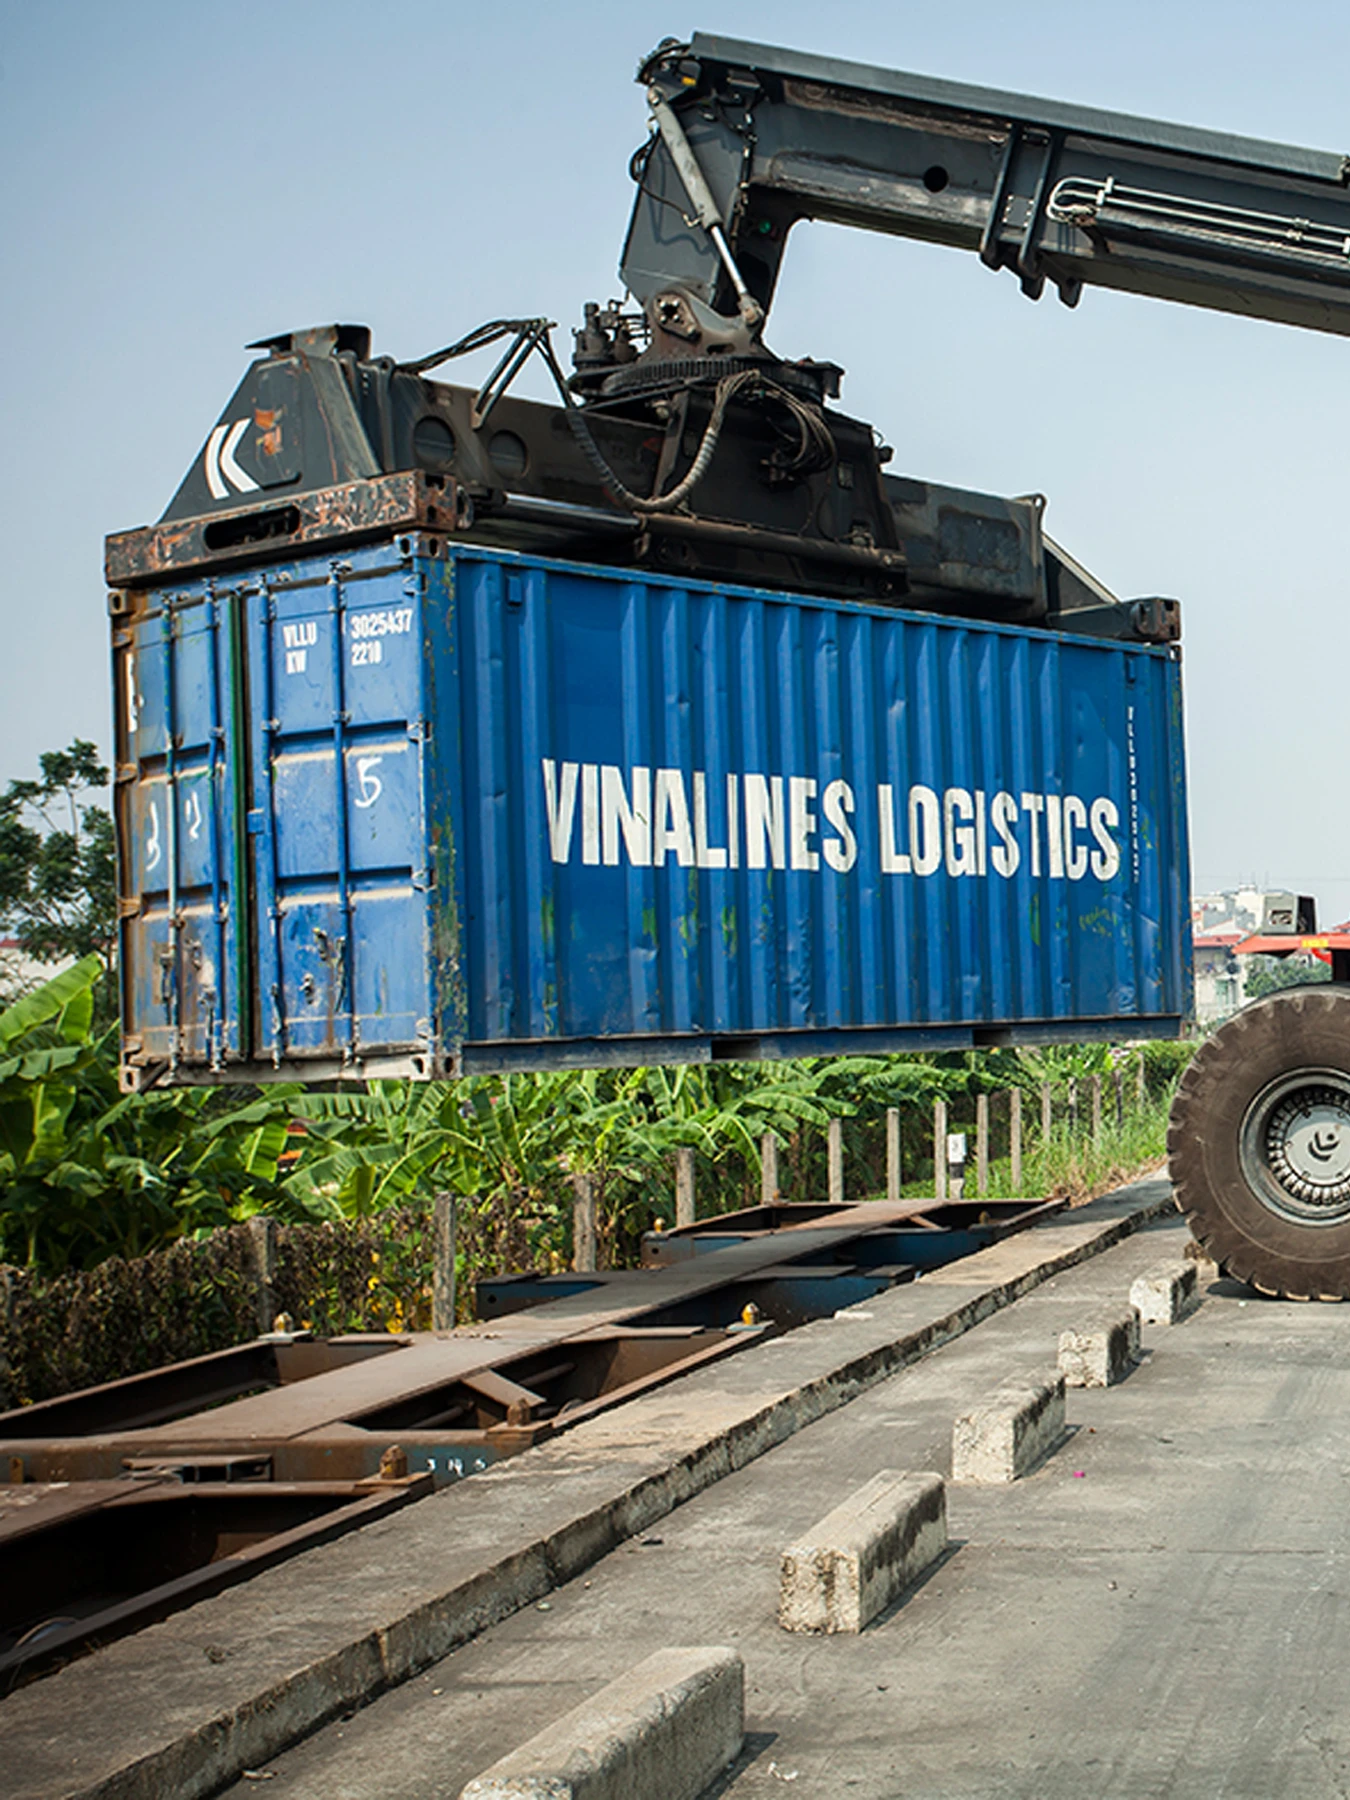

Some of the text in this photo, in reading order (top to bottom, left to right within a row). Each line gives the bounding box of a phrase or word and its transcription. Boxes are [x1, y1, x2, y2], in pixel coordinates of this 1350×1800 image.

[350, 607, 413, 640] 3025437
[353, 755, 384, 808] 5
[542, 758, 1120, 882] VINALINES LOGISTICS
